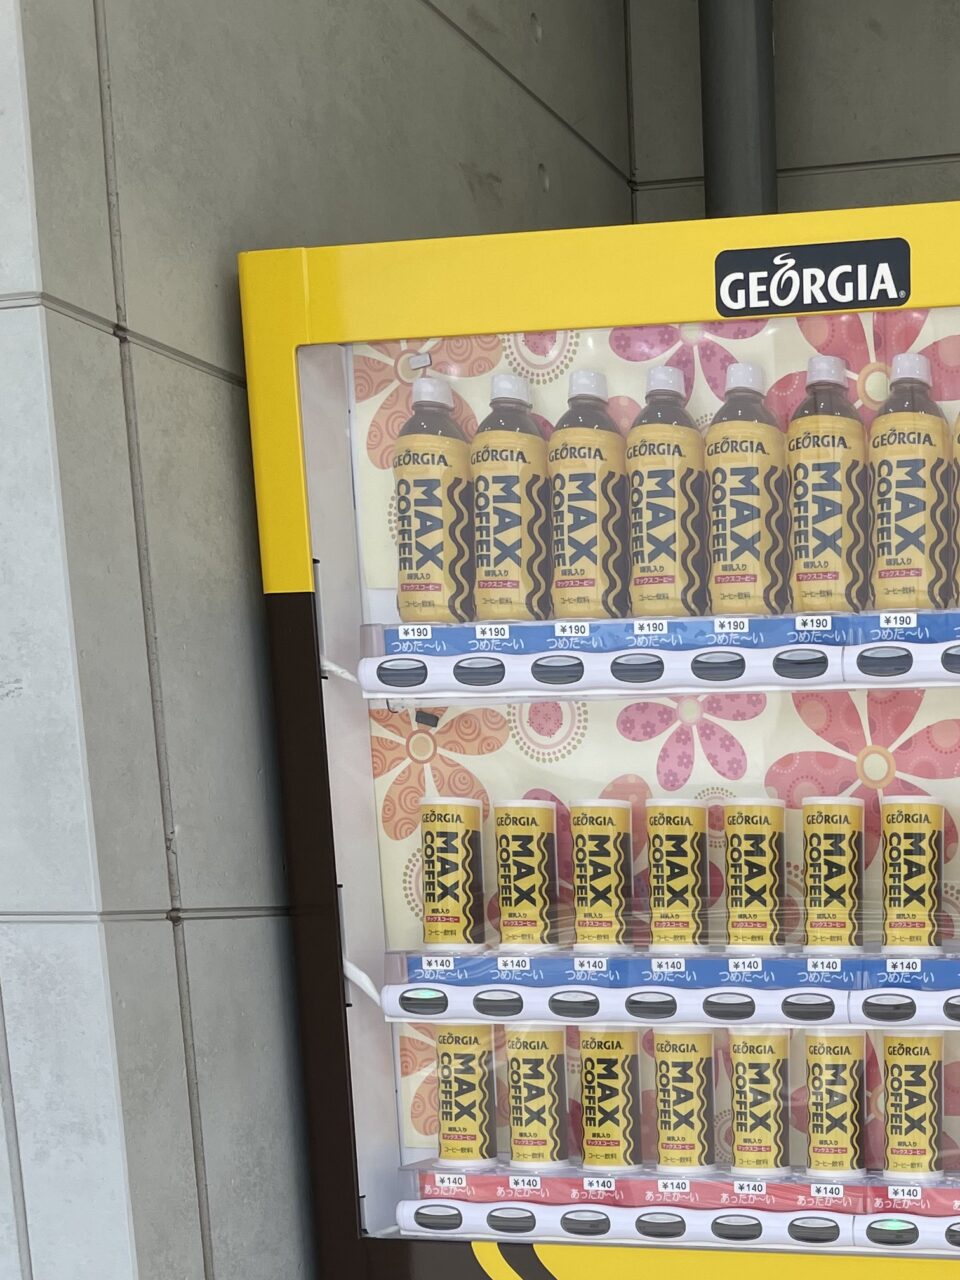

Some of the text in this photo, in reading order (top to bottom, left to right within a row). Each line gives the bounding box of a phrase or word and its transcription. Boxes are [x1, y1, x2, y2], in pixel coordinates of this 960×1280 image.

[719, 252, 901, 310] GEORGIA
[627, 436, 685, 459] GEORGIA
[788, 431, 848, 451] GEORGIA
[393, 446, 449, 467] GEORGIA
[646, 469, 677, 562] MAX
[793, 462, 810, 560] COFFEE
[811, 461, 843, 559] MAX
[398, 478, 413, 571] COFFEE
[413, 478, 444, 571] MAX
[403, 627, 429, 637] ¥190
[638, 622, 665, 632] ¥190
[801, 617, 829, 628] ¥190
[424, 831, 435, 903] COFFEE
[426, 959, 451, 968] ¥140
[734, 961, 759, 970] ¥140
[438, 1177, 463, 1186] ¥140
[816, 1186, 841, 1195] ¥140
